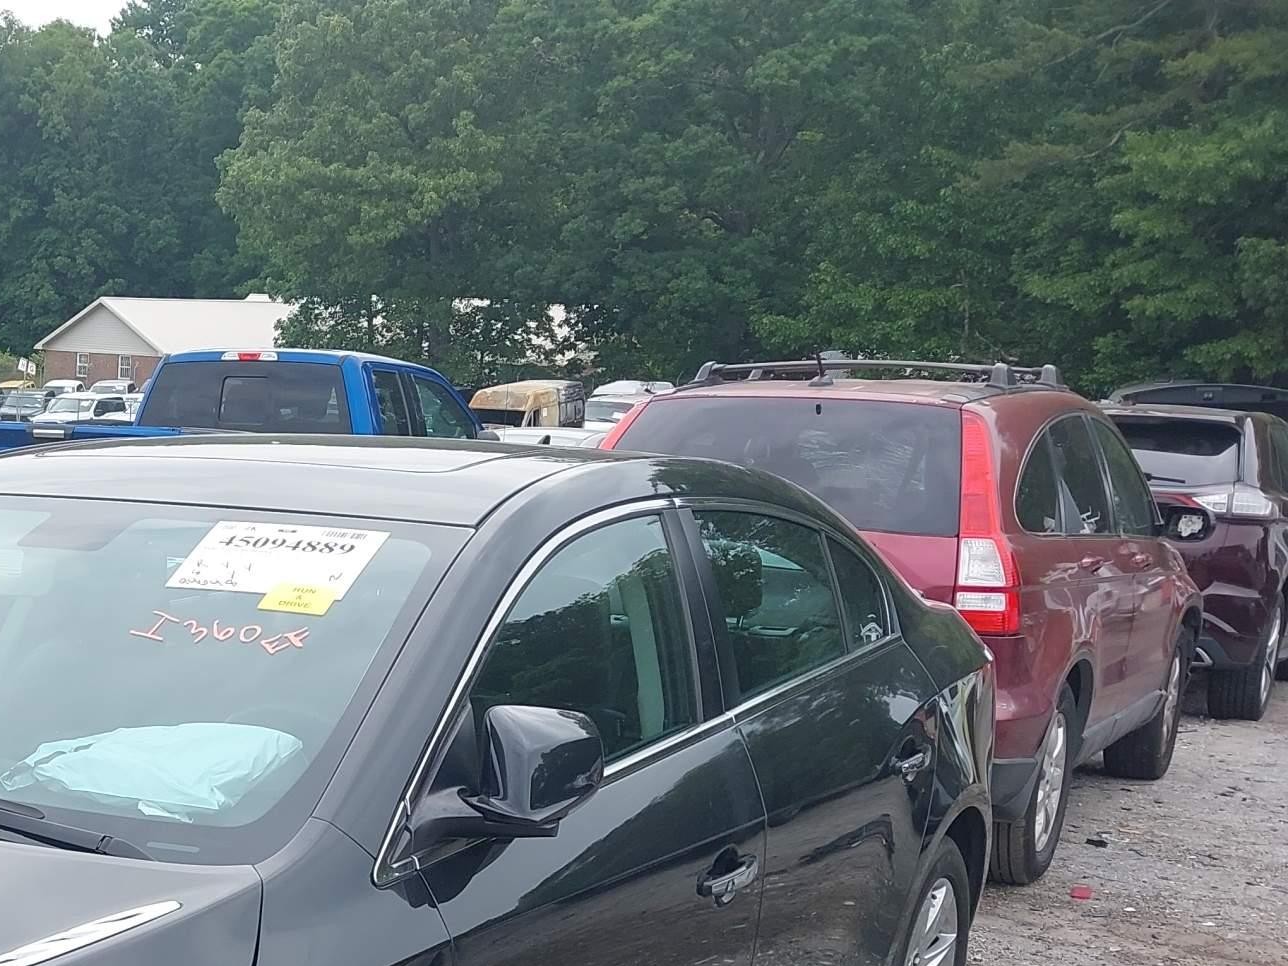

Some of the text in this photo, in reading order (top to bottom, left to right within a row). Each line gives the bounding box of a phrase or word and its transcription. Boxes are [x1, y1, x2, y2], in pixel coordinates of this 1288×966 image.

[219, 534, 356, 555] 45094889
[292, 586, 317, 595] RUN
[278, 600, 312, 609] DRIVE
